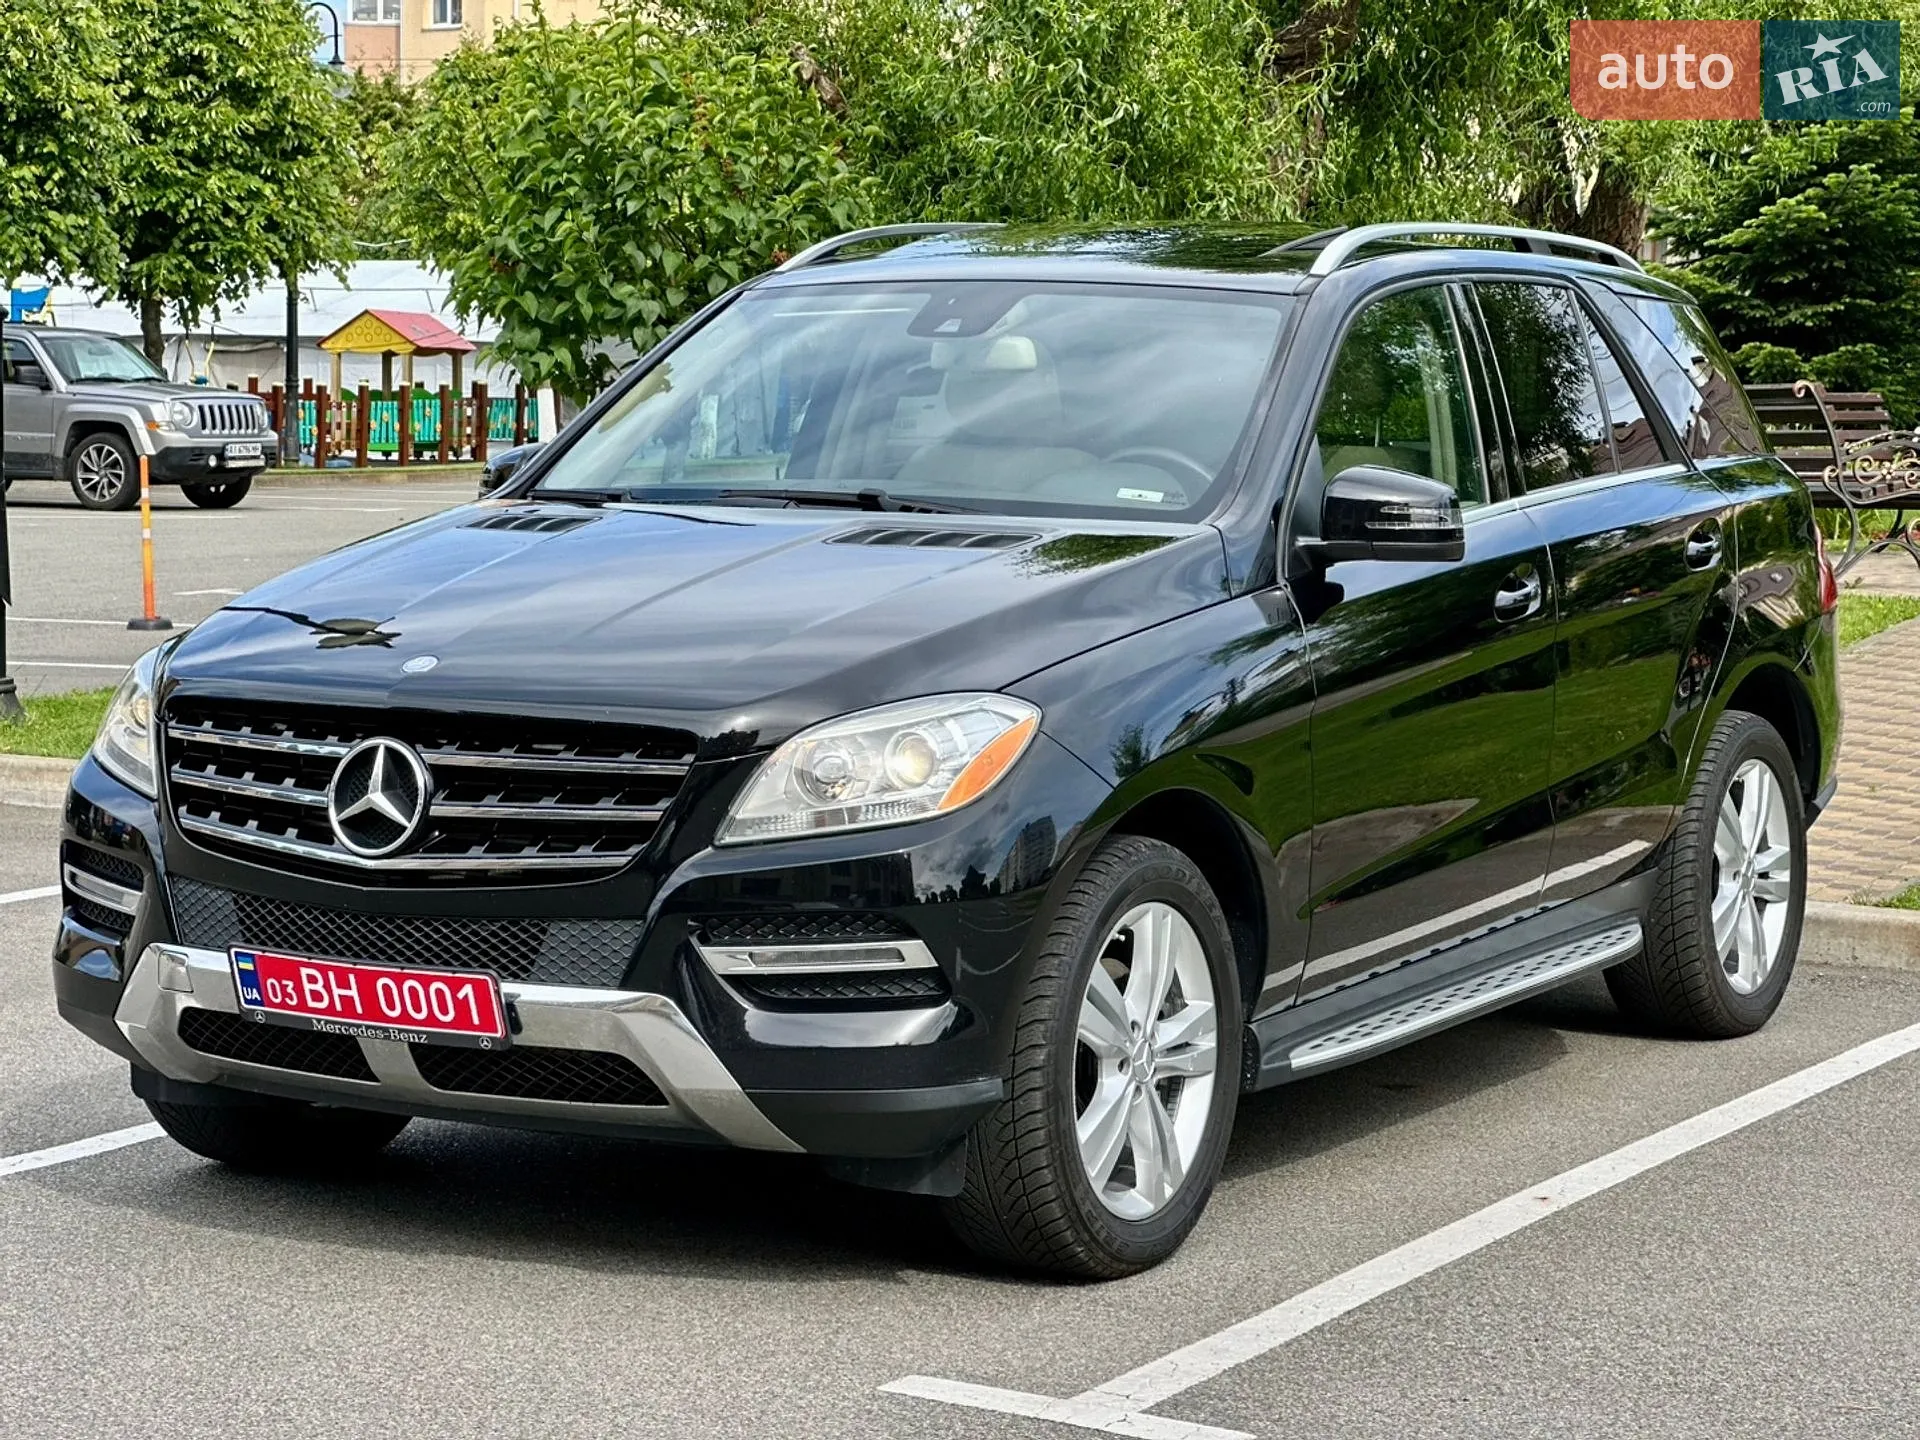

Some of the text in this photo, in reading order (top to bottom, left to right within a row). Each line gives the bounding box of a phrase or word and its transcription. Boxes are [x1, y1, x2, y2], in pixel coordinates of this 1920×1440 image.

[242, 986, 262, 1001] UA
[266, 966, 480, 1026] 03 BH 0001
[311, 1018, 429, 1044] Mercedes-Benz
